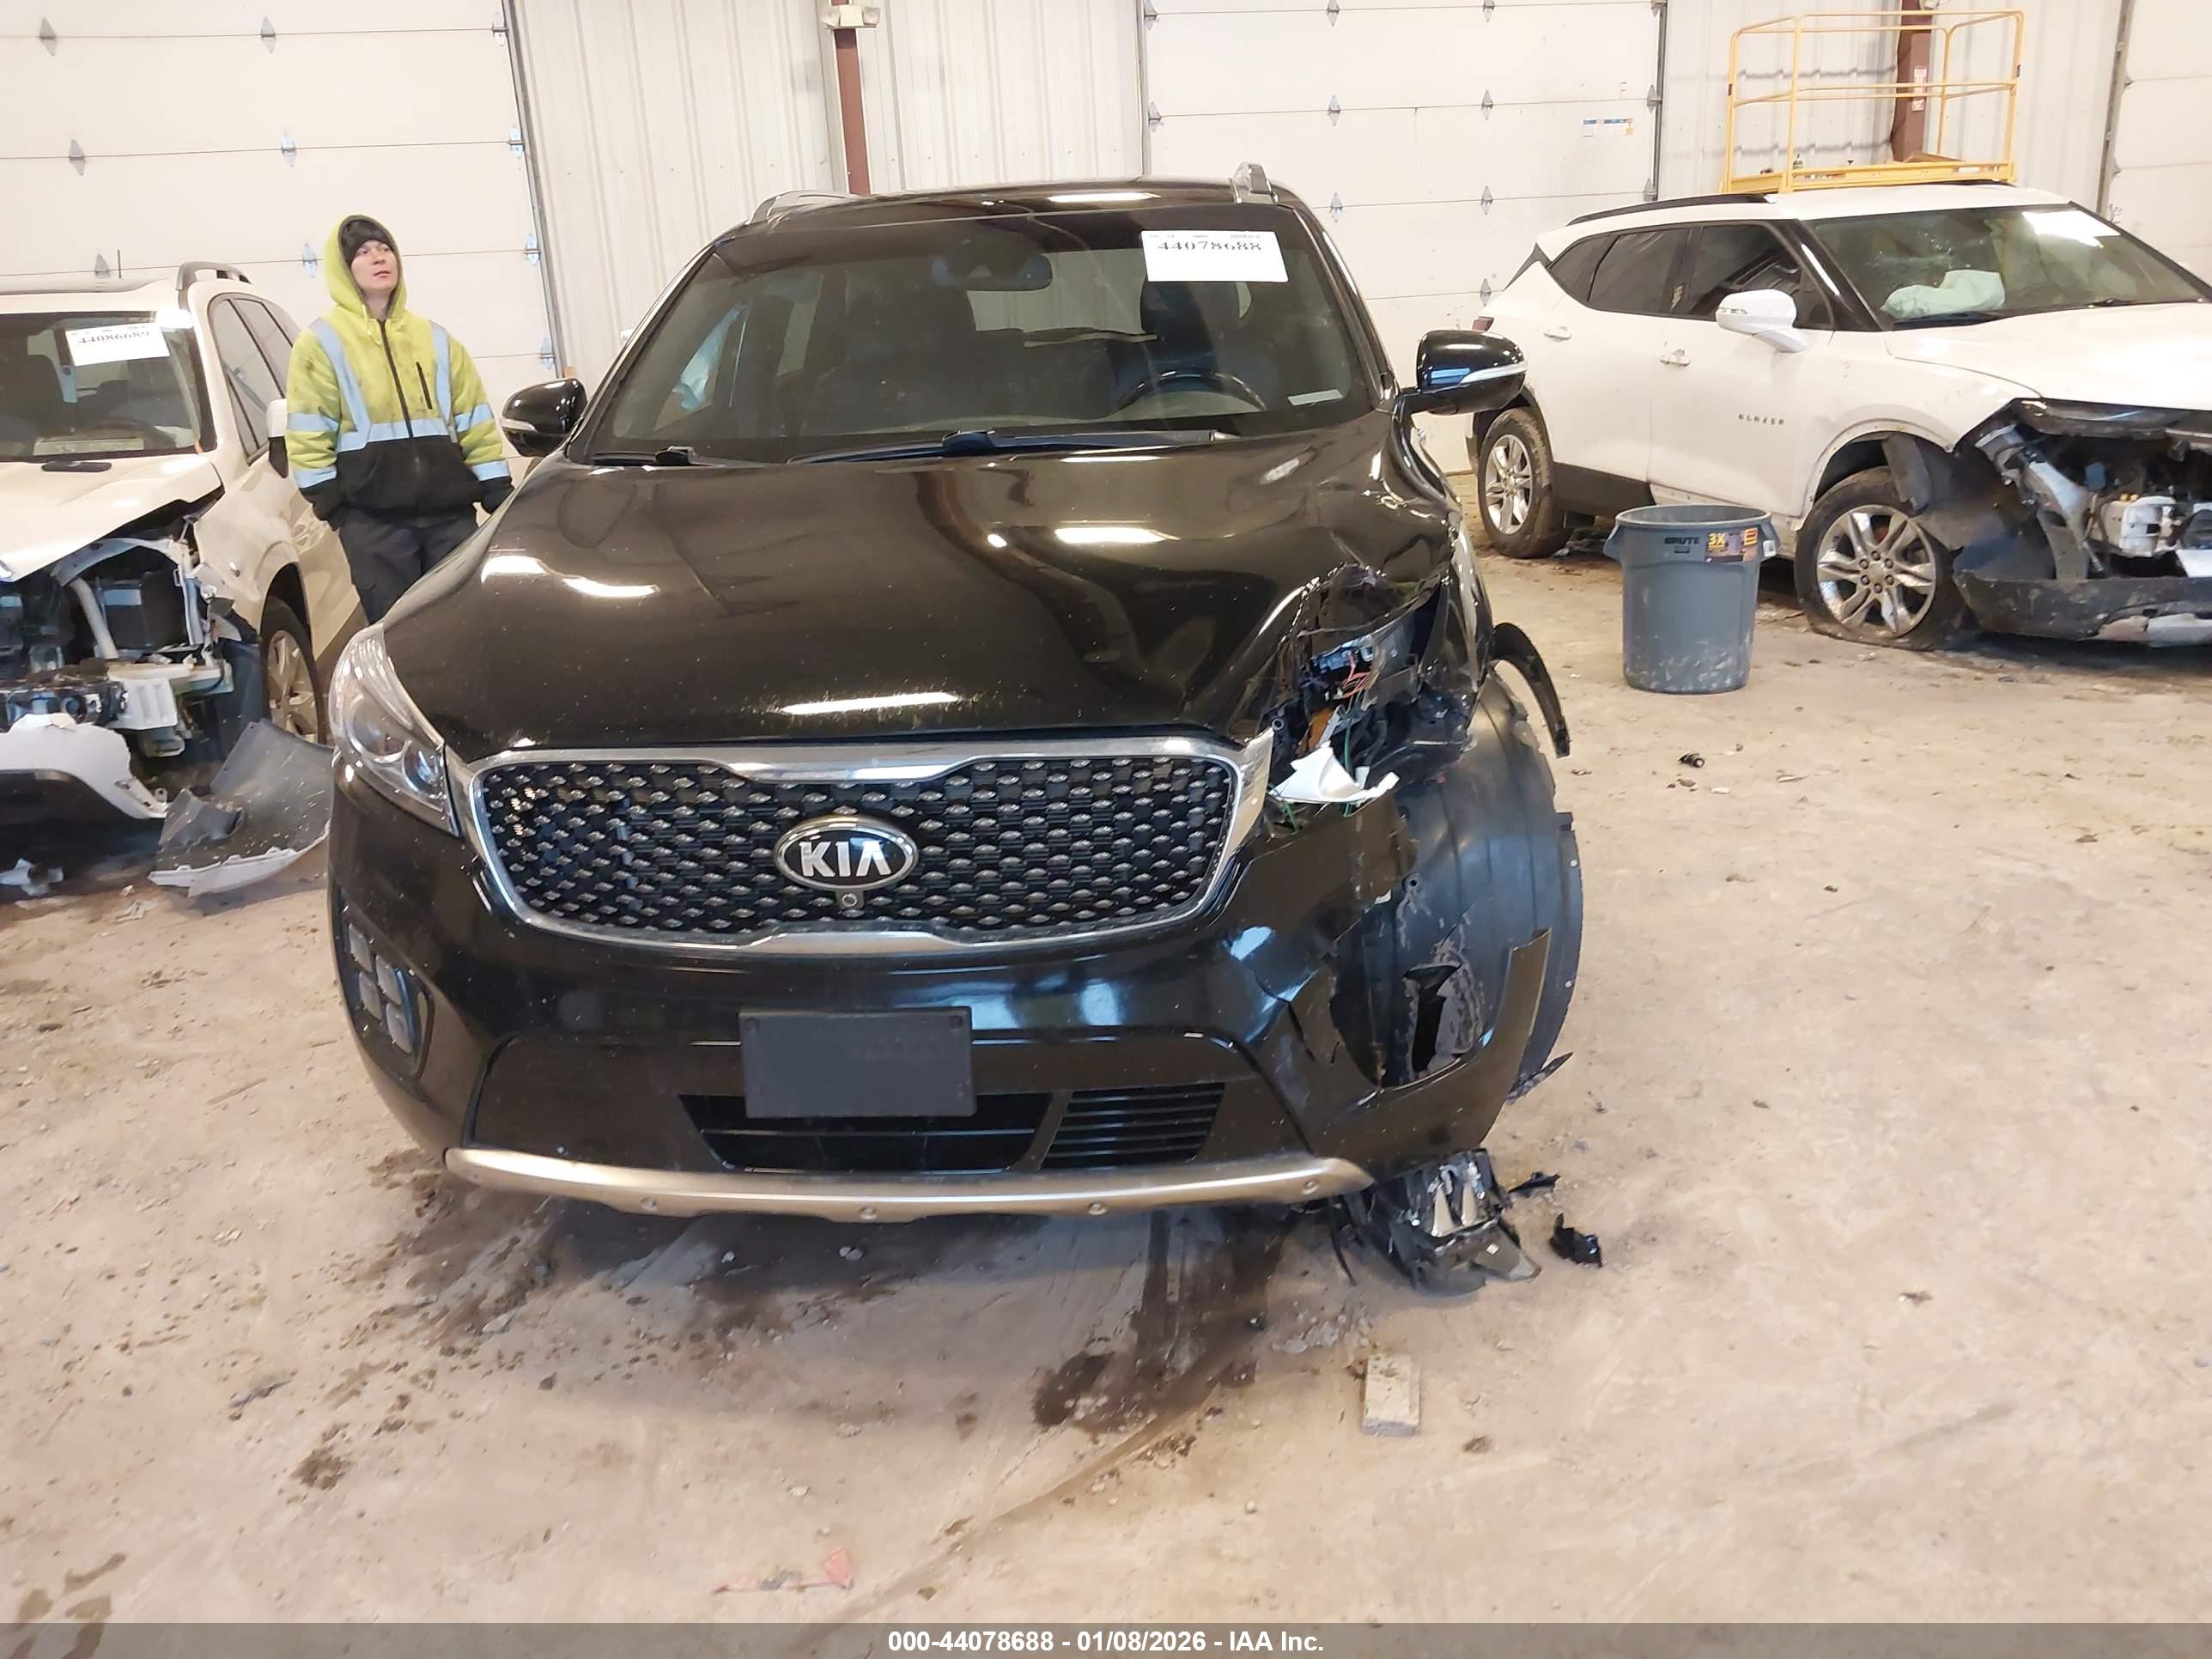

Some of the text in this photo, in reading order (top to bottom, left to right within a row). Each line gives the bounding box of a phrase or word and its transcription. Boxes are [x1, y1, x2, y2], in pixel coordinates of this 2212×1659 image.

[1158, 240, 1262, 251] 44078688
[78, 330, 149, 343] 44086689
[1737, 413, 1784, 426] BLAZER
[1664, 537, 1700, 545] BRUTE
[1708, 532, 1726, 545] 3X
[799, 840, 892, 878] KIA
